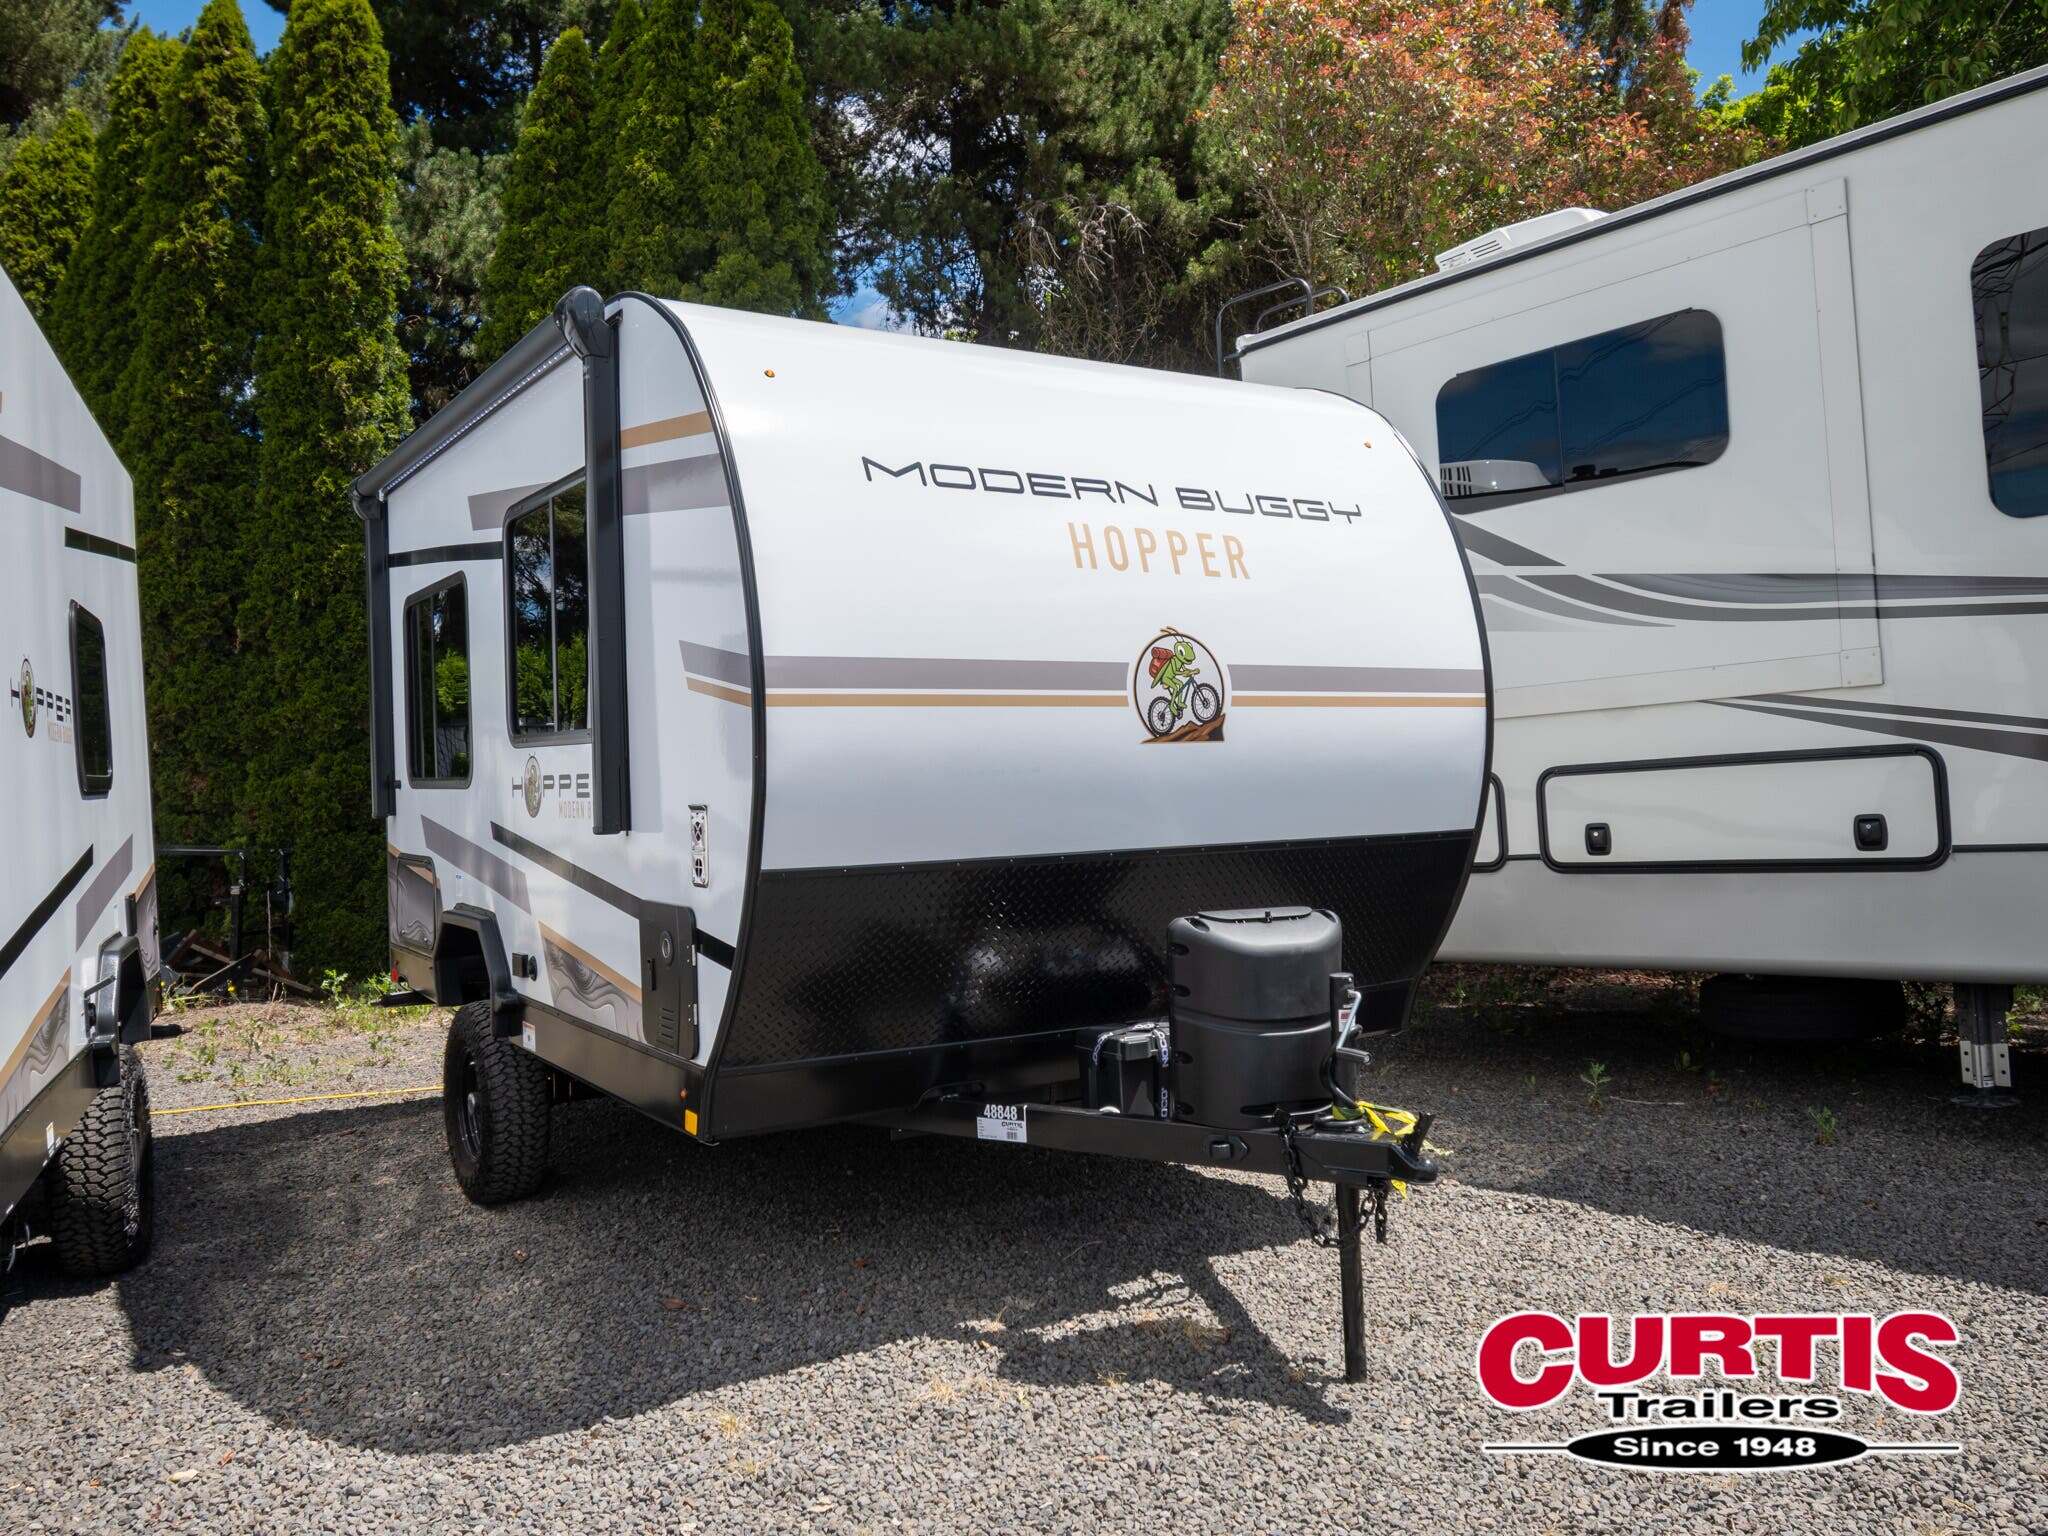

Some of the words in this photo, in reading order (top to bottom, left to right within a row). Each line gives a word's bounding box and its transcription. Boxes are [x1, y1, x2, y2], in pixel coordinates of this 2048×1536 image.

[862, 456, 1159, 506] MODERN
[1175, 486, 1362, 524] BUGGY
[1066, 521, 1250, 580] HOPPER
[983, 1104, 1018, 1120] 48848
